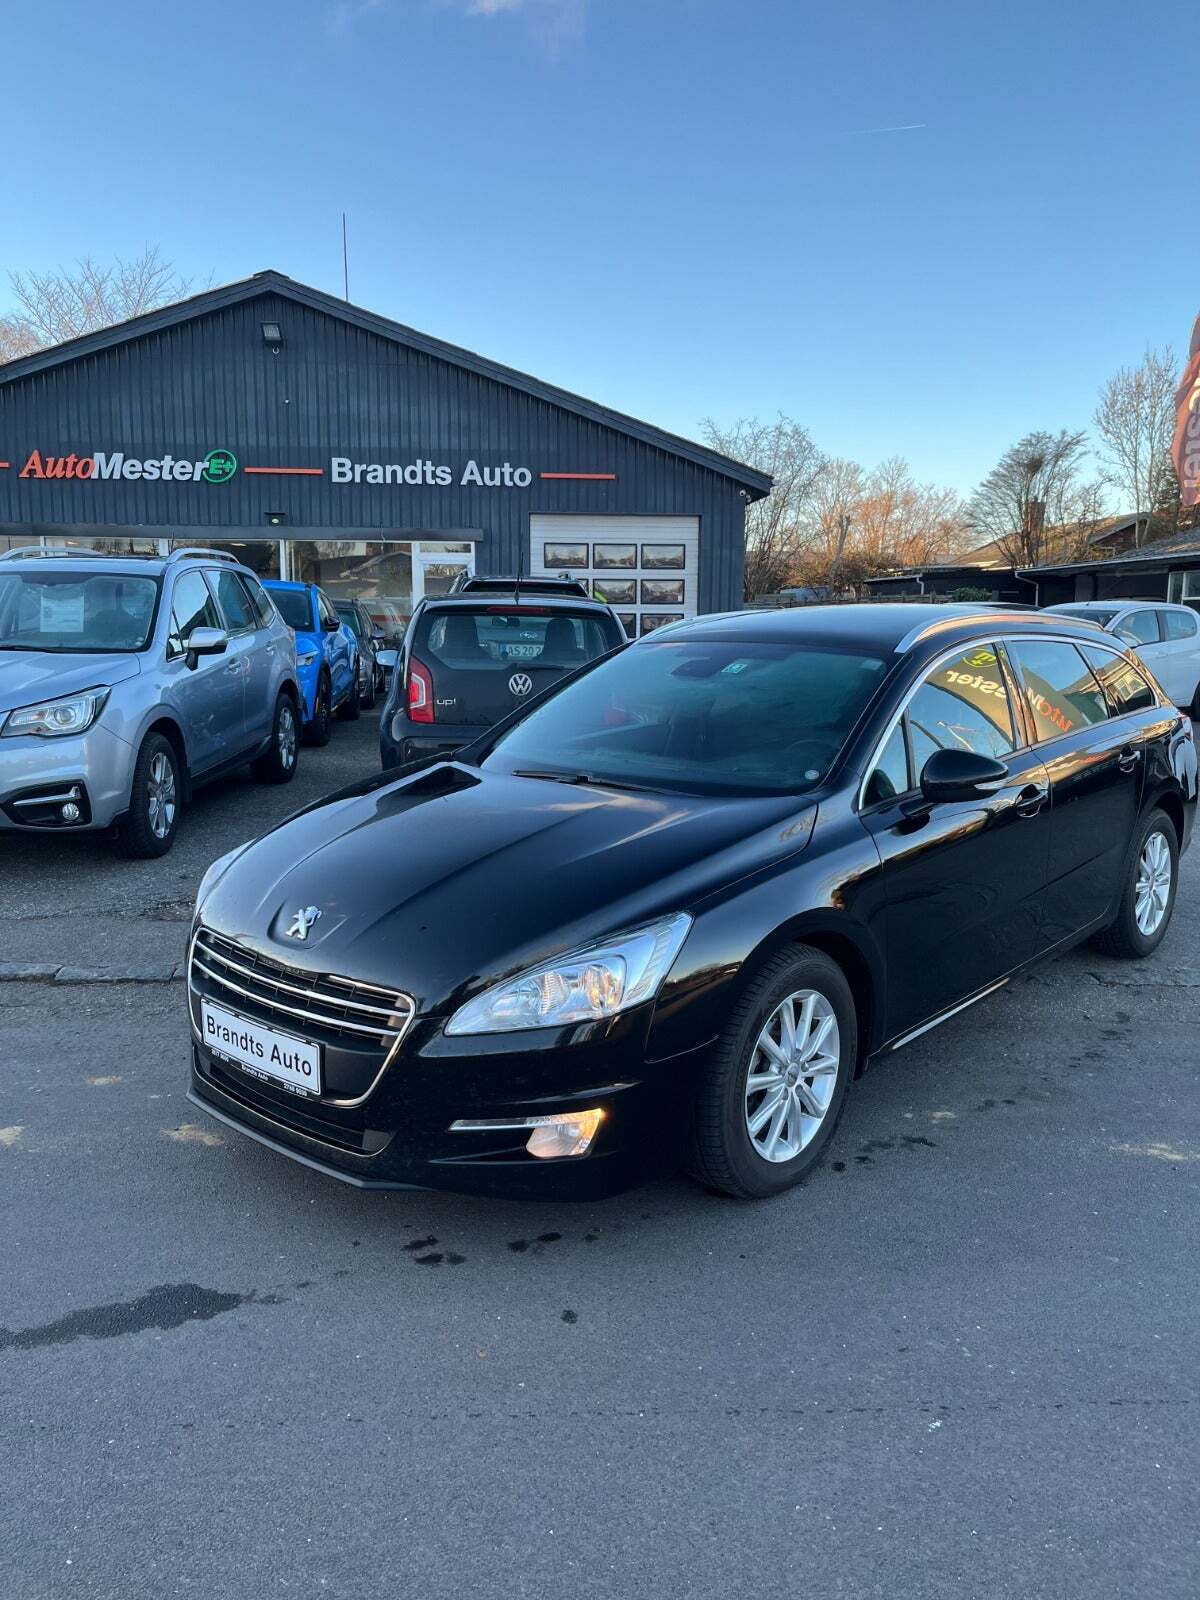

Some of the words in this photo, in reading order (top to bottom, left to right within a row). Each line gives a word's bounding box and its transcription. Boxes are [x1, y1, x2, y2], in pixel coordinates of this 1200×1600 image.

[19, 449, 209, 481] AutoMester
[331, 457, 452, 486] Brandts
[460, 460, 532, 487] Auto
[436, 697, 456, 707] up!
[206, 1014, 264, 1058] Brandts
[270, 1044, 312, 1077] Auto
